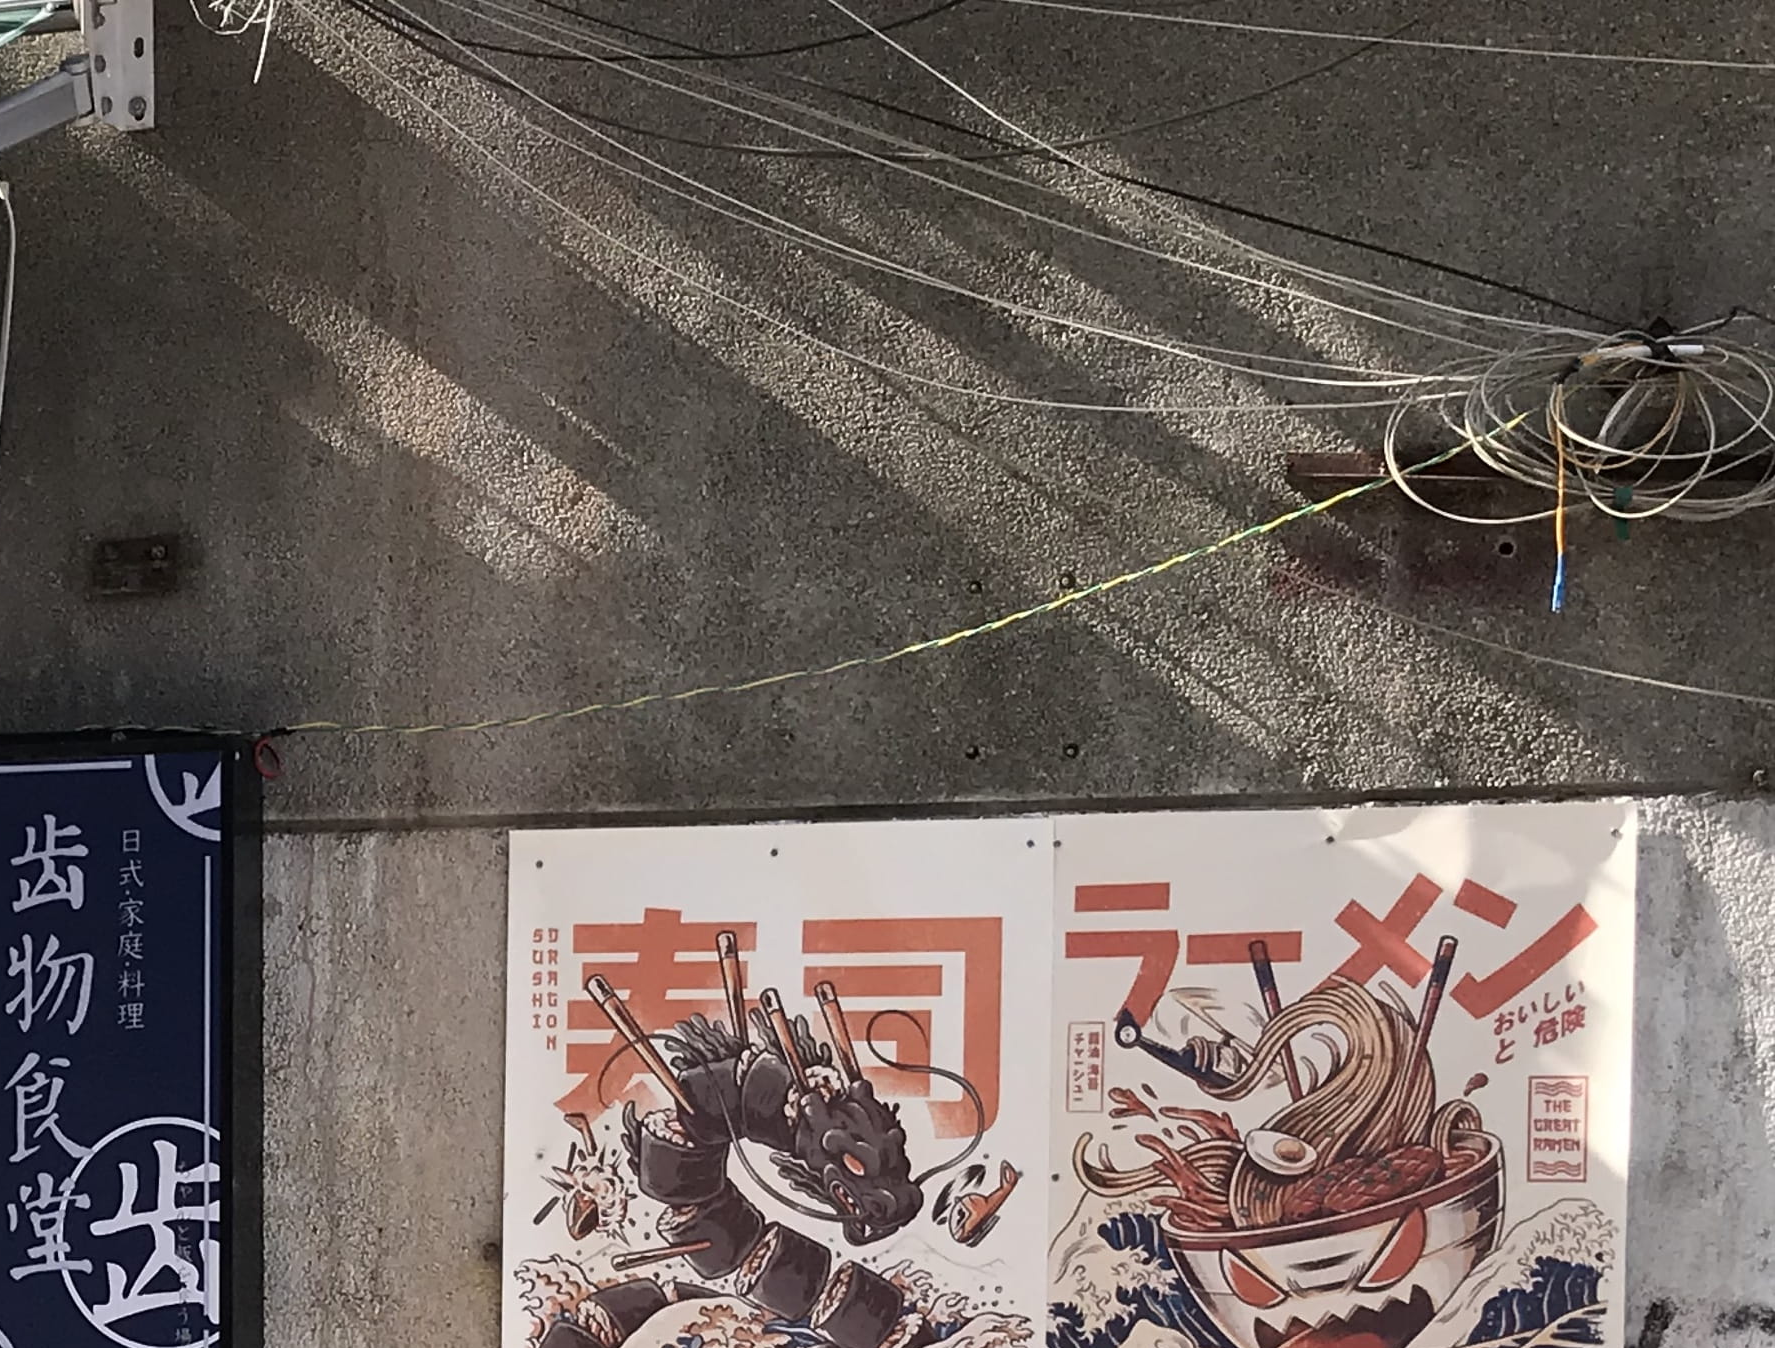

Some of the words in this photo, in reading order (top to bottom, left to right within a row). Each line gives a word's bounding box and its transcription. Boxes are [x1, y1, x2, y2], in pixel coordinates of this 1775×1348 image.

[531, 927, 544, 1030] SUSHI
[1065, 873, 1598, 1028] ラーメン
[545, 926, 560, 1051] DRAGON
[1493, 980, 1586, 1037] おいしい
[1533, 1118, 1581, 1133] GREAT
[1543, 1099, 1572, 1113] THE
[1532, 1137, 1581, 1153] RAMEN
